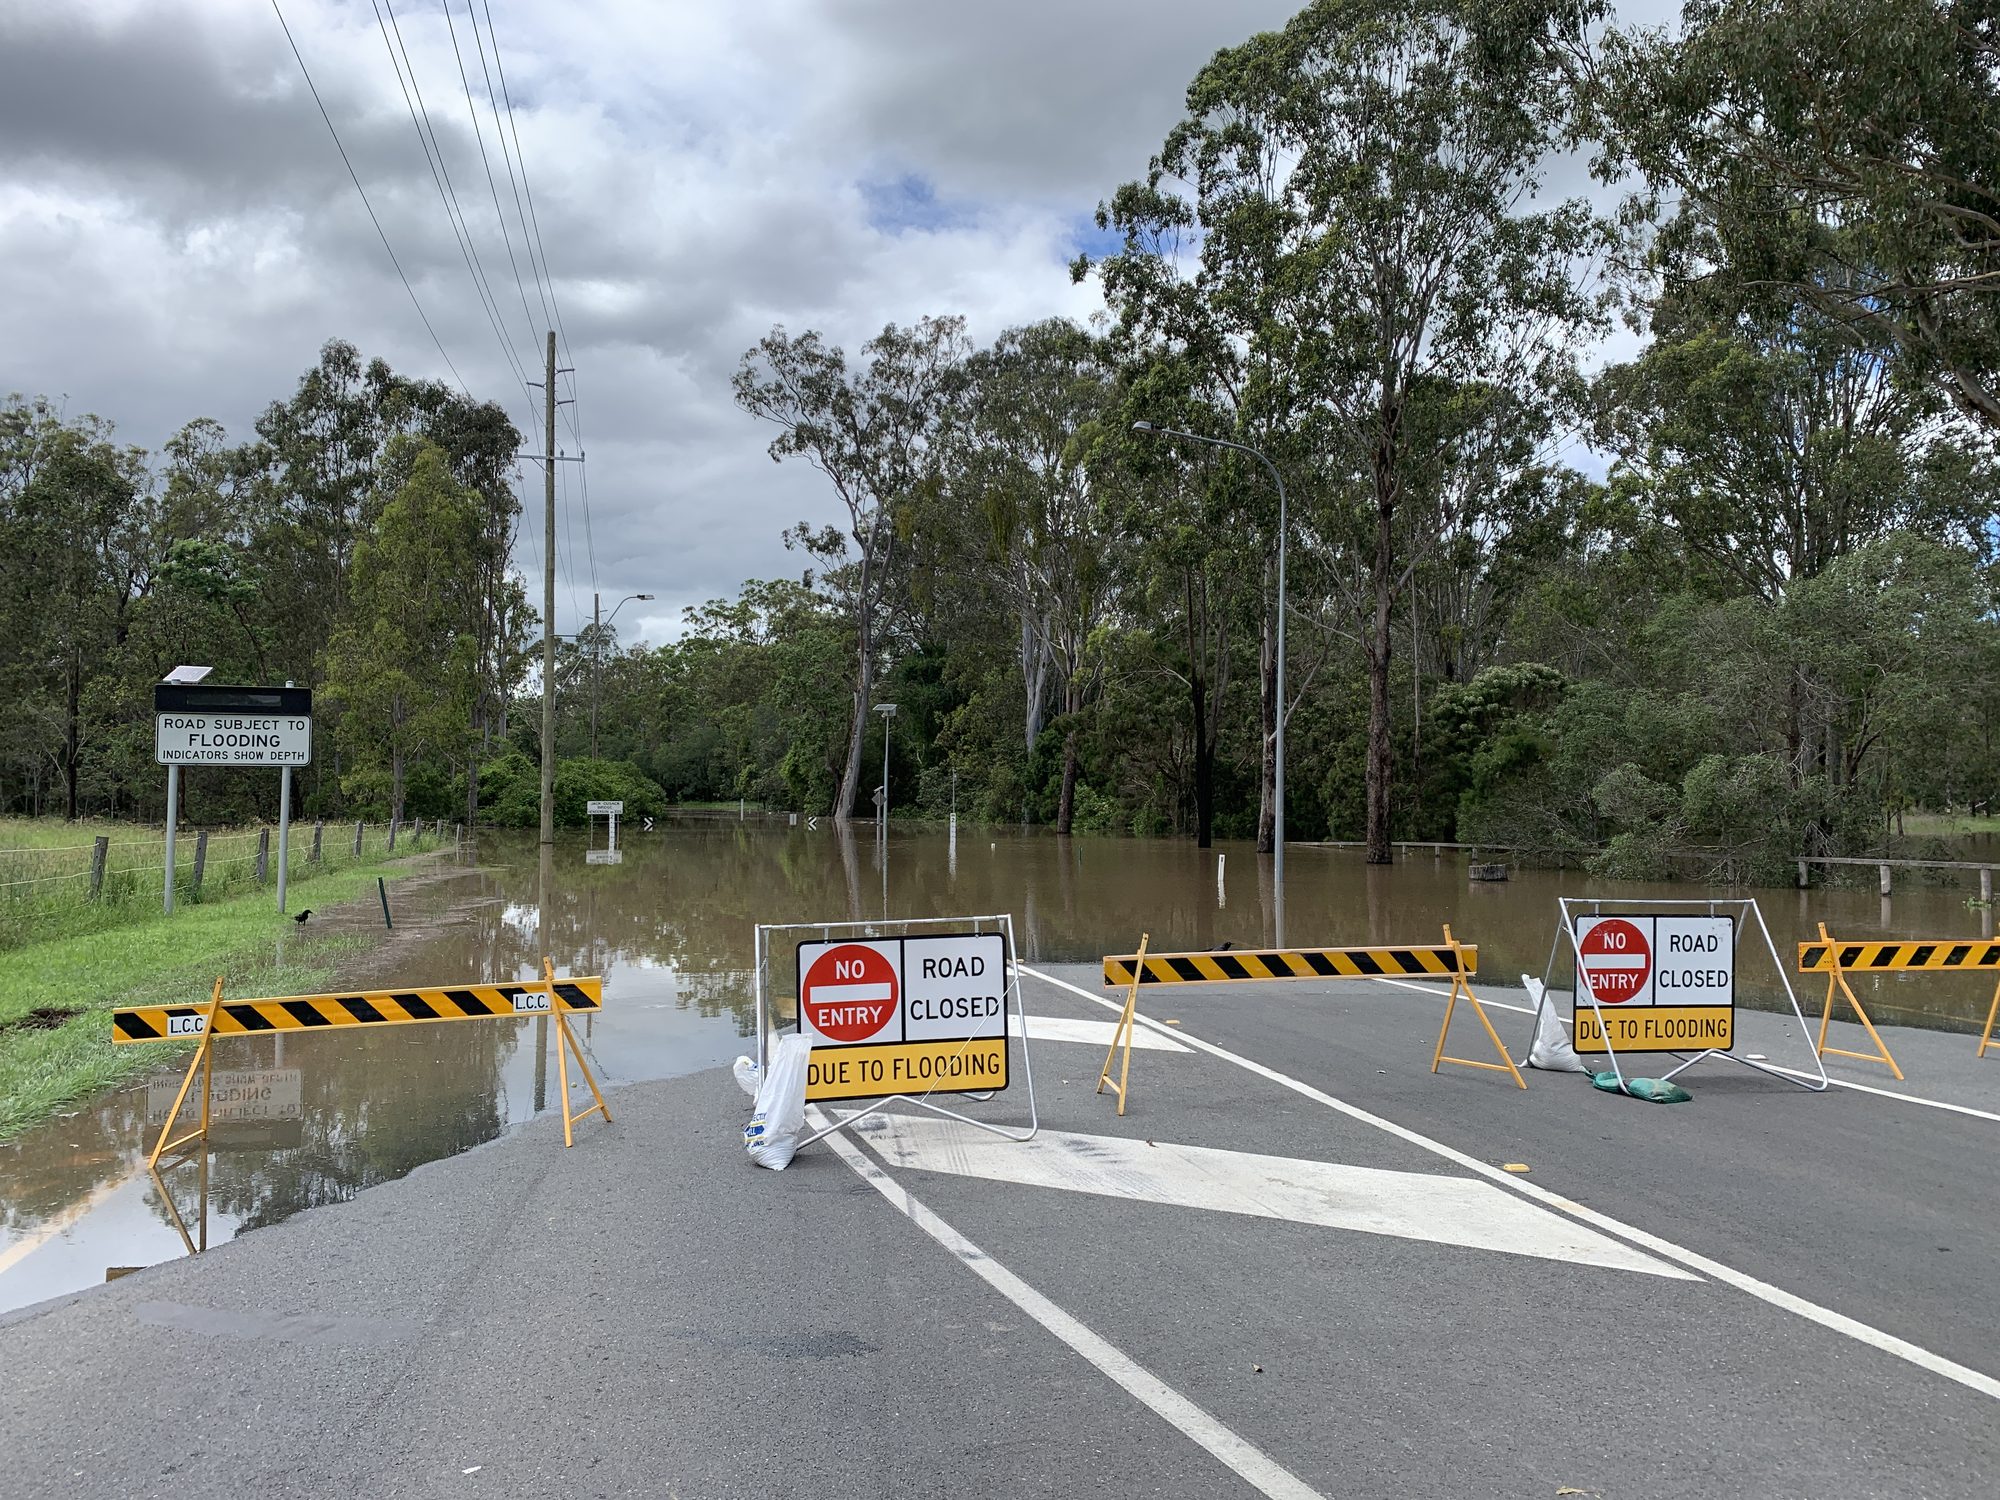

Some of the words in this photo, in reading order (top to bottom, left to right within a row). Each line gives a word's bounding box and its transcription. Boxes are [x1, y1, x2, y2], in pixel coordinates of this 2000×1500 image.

[164, 718, 206, 729] ROAD
[214, 719, 280, 731] SUBJECT
[288, 720, 305, 731] TO
[188, 733, 281, 747] FLOODING
[162, 750, 229, 760] INDICATORS
[234, 750, 264, 761] SHOW
[270, 751, 305, 761] DEPTH
[1603, 932, 1626, 950] NO
[1670, 934, 1719, 953] ROAD
[835, 959, 865, 980] NO
[922, 956, 985, 979] ROAD
[1589, 973, 1639, 990] ENTRY
[1659, 970, 1729, 988] CLOSED
[515, 994, 549, 1010] L.C.C.
[910, 996, 1000, 1021] CLOSED
[818, 1005, 883, 1027] ENTRY
[1580, 1020, 1611, 1040] DUE
[1618, 1020, 1638, 1039] TO
[1645, 1018, 1727, 1039] FLOODING
[807, 1061, 850, 1086] DUE
[858, 1059, 884, 1082] TO
[893, 1052, 1001, 1080] FLOODING
